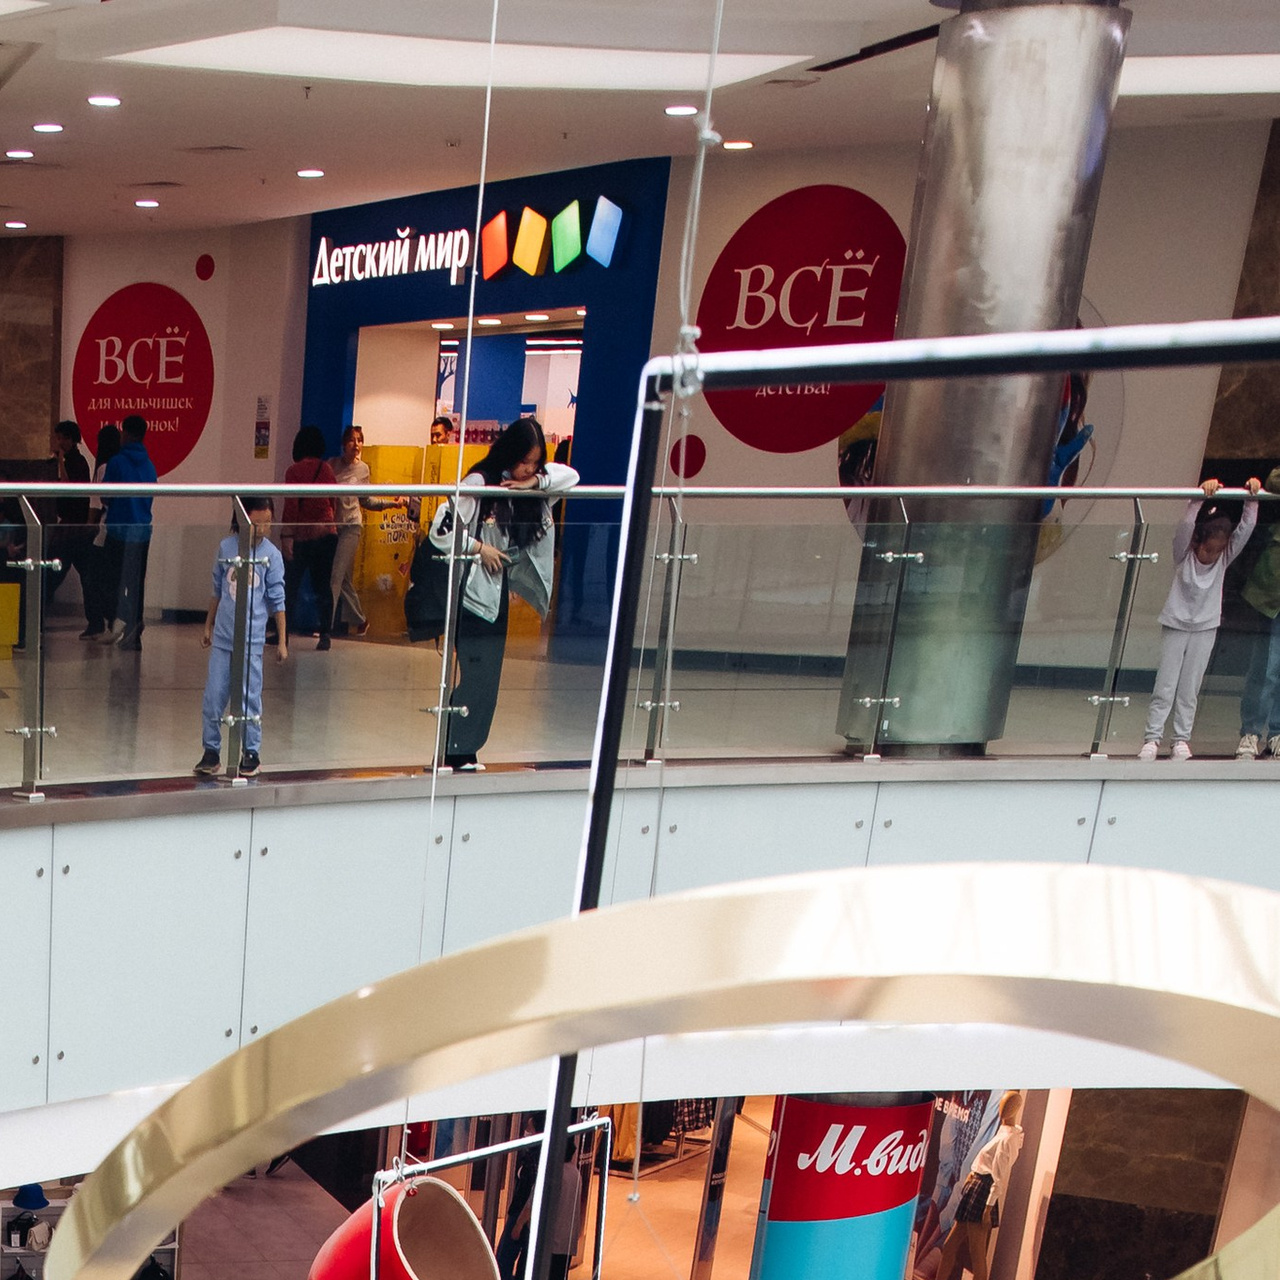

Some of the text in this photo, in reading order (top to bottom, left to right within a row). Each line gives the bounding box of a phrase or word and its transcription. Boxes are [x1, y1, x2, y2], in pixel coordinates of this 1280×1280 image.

[312, 226, 469, 287] Детский мир
[726, 249, 880, 336] ВСЁ
[93, 326, 190, 389] ВСЁ
[88, 397, 193, 411] для мальчишек
